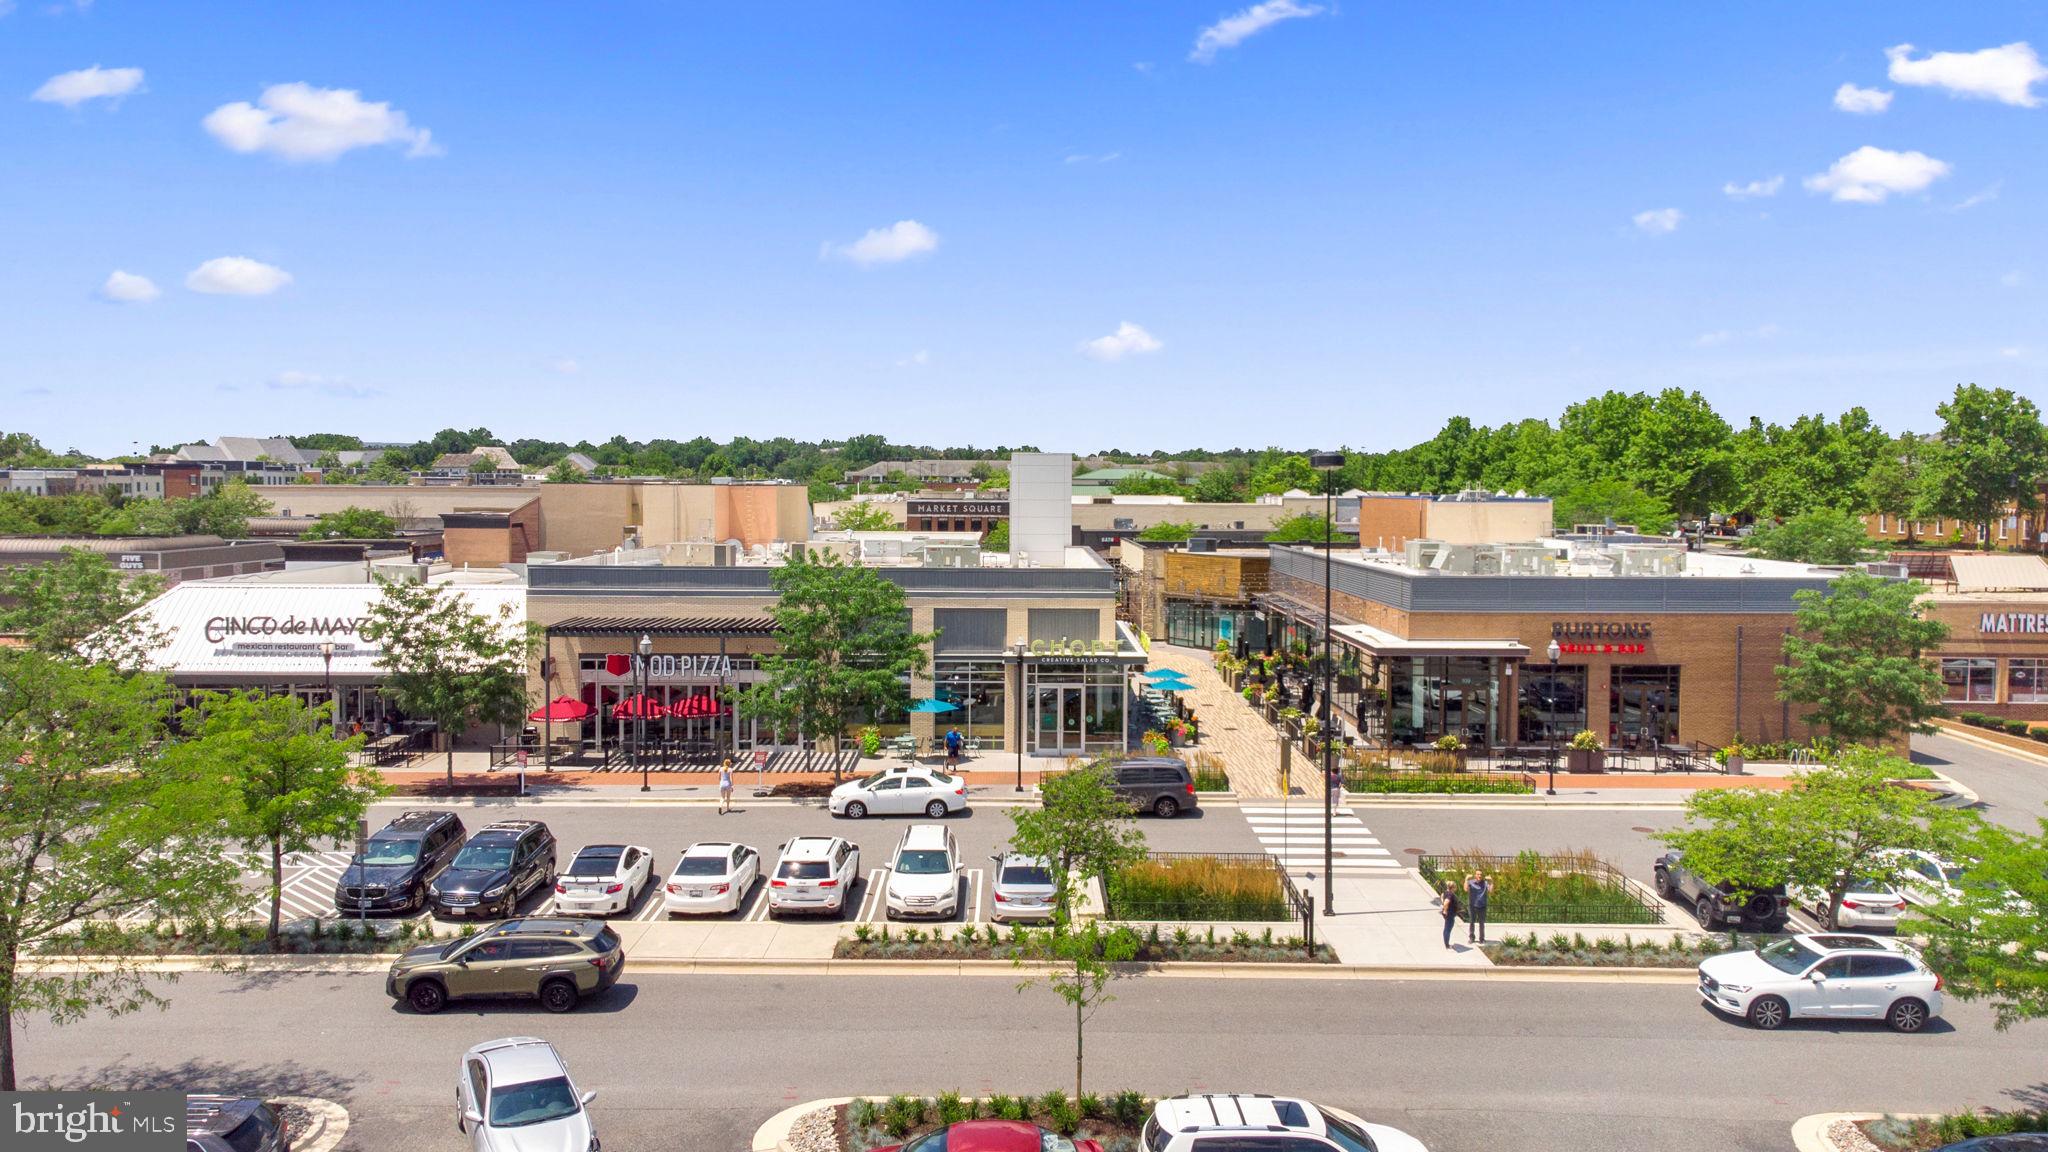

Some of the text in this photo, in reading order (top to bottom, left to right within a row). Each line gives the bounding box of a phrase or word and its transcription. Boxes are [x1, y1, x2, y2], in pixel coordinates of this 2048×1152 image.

[918, 504, 1002, 513] MARKET SQUARE
[204, 616, 277, 643] CINCO
[281, 615, 306, 635] de
[1552, 622, 1652, 640] BURTONS
[335, 643, 350, 651] bar
[1030, 639, 1126, 657] CHOPT
[681, 655, 733, 677] PIZZA
